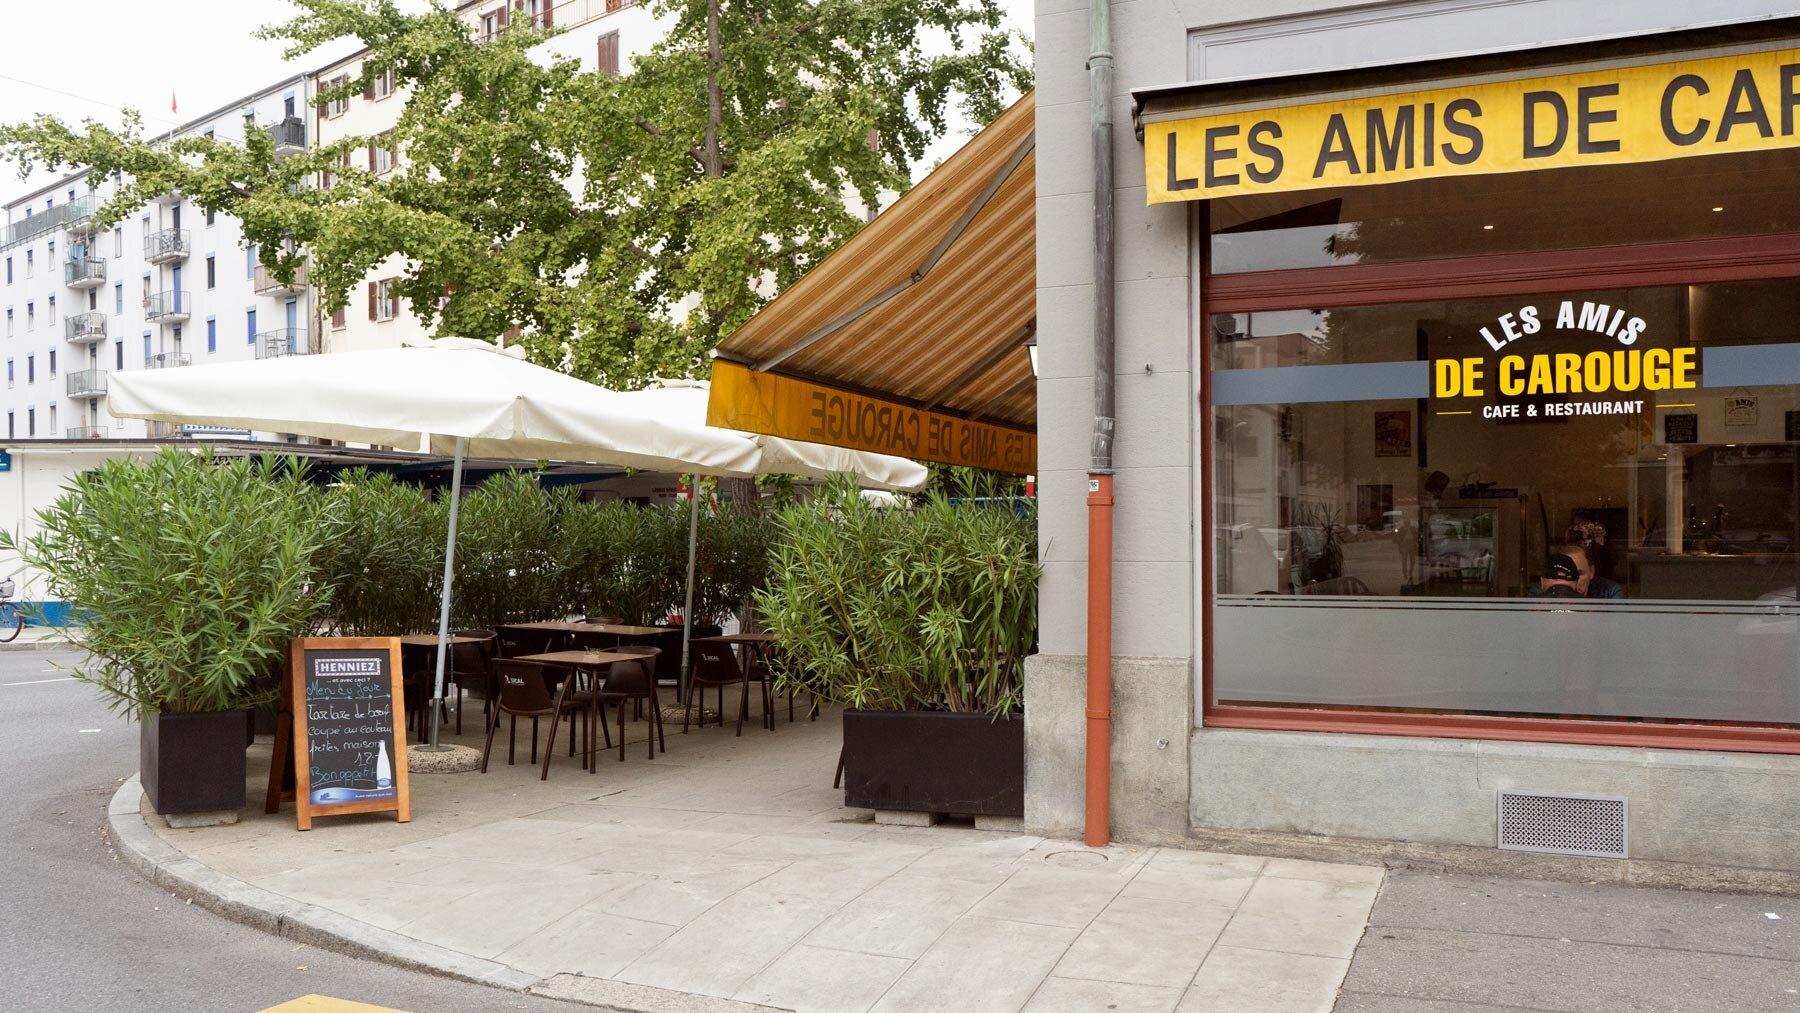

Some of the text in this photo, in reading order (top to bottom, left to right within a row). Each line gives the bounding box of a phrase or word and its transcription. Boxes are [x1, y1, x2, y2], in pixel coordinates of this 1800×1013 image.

[1166, 120, 1284, 191] LES
[1312, 97, 1484, 178] AMIS
[1523, 83, 1621, 160] DE
[1479, 300, 1647, 351] LES AMIS
[1436, 347, 1696, 398] DE CAROUGE
[1483, 400, 1644, 418] CAFE & RESTAURANT
[320, 662, 376, 672] HENNIEZ
[307, 703, 350, 720] Tartare
[355, 703, 365, 718] de
[343, 726, 357, 734] au
[360, 720, 392, 733] couteau
[343, 740, 381, 750] maison
